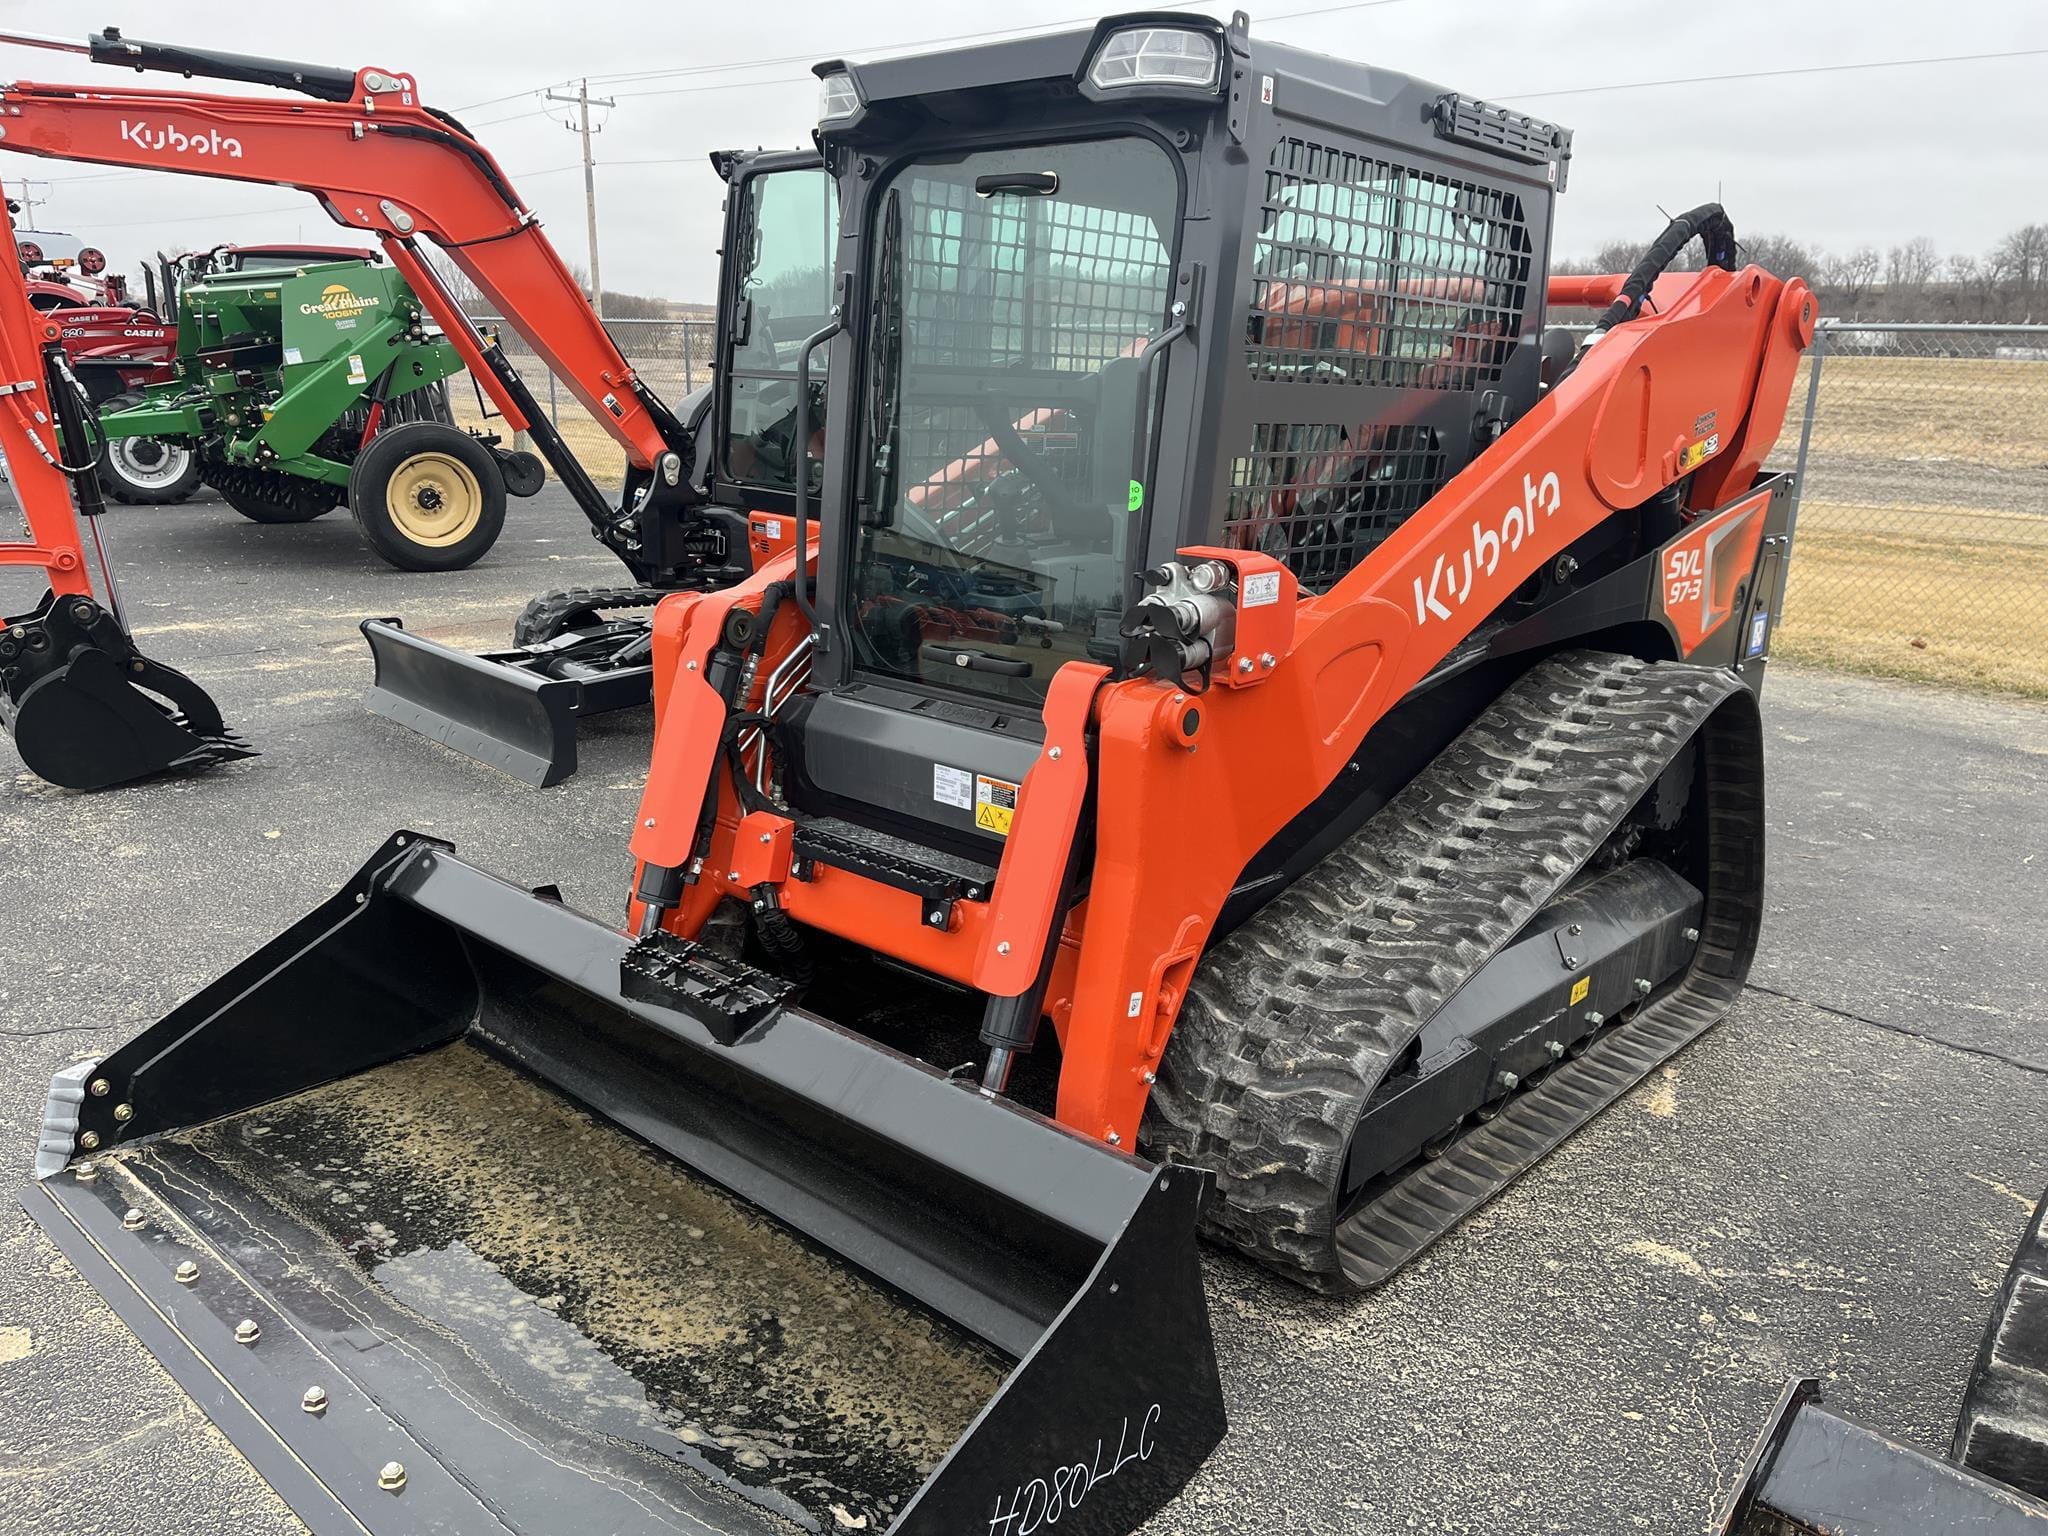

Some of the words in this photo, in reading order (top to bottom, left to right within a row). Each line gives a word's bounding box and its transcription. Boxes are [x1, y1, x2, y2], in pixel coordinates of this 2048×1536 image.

[120, 119, 243, 158] Kubota
[300, 302, 338, 315] Great
[338, 295, 380, 310] Plains
[68, 315, 90, 323] CASE
[123, 329, 153, 338] CASE
[154, 328, 165, 338] IH
[1413, 471, 1561, 626] Kubota
[1667, 549, 1702, 580] SVL
[1668, 579, 1702, 604] 97-3
